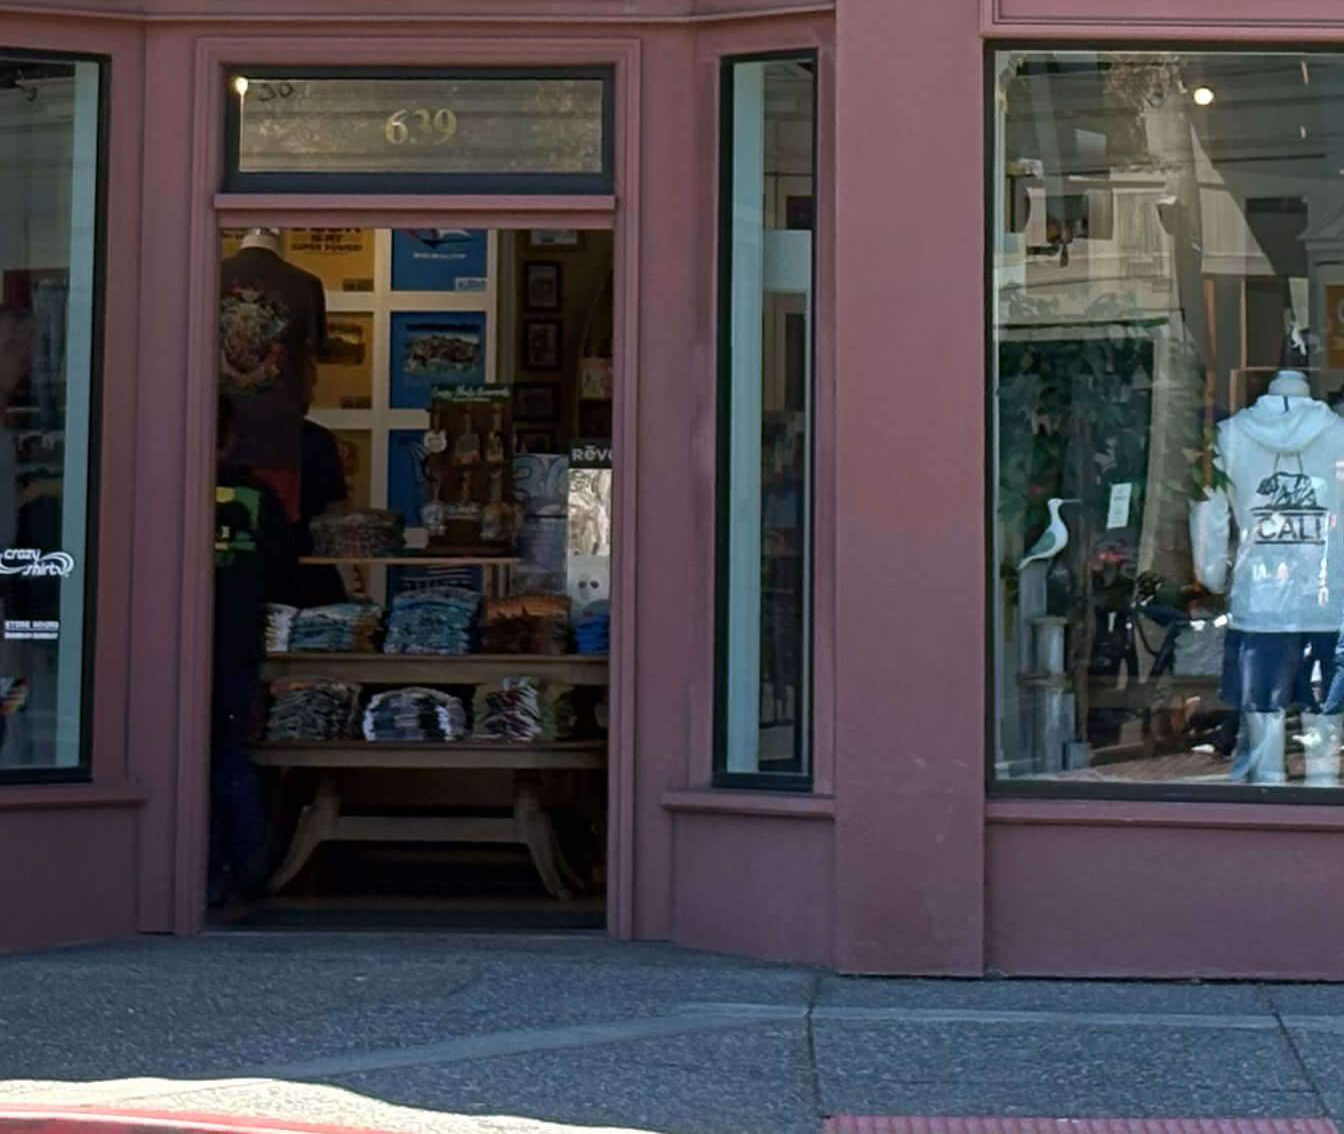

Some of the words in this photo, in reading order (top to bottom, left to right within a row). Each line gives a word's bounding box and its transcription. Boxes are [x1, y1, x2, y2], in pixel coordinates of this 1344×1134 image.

[383, 107, 458, 145] 639
[1257, 515, 1321, 539] CALI
[3, 548, 41, 562] crazy
[21, 561, 66, 576] shirts
